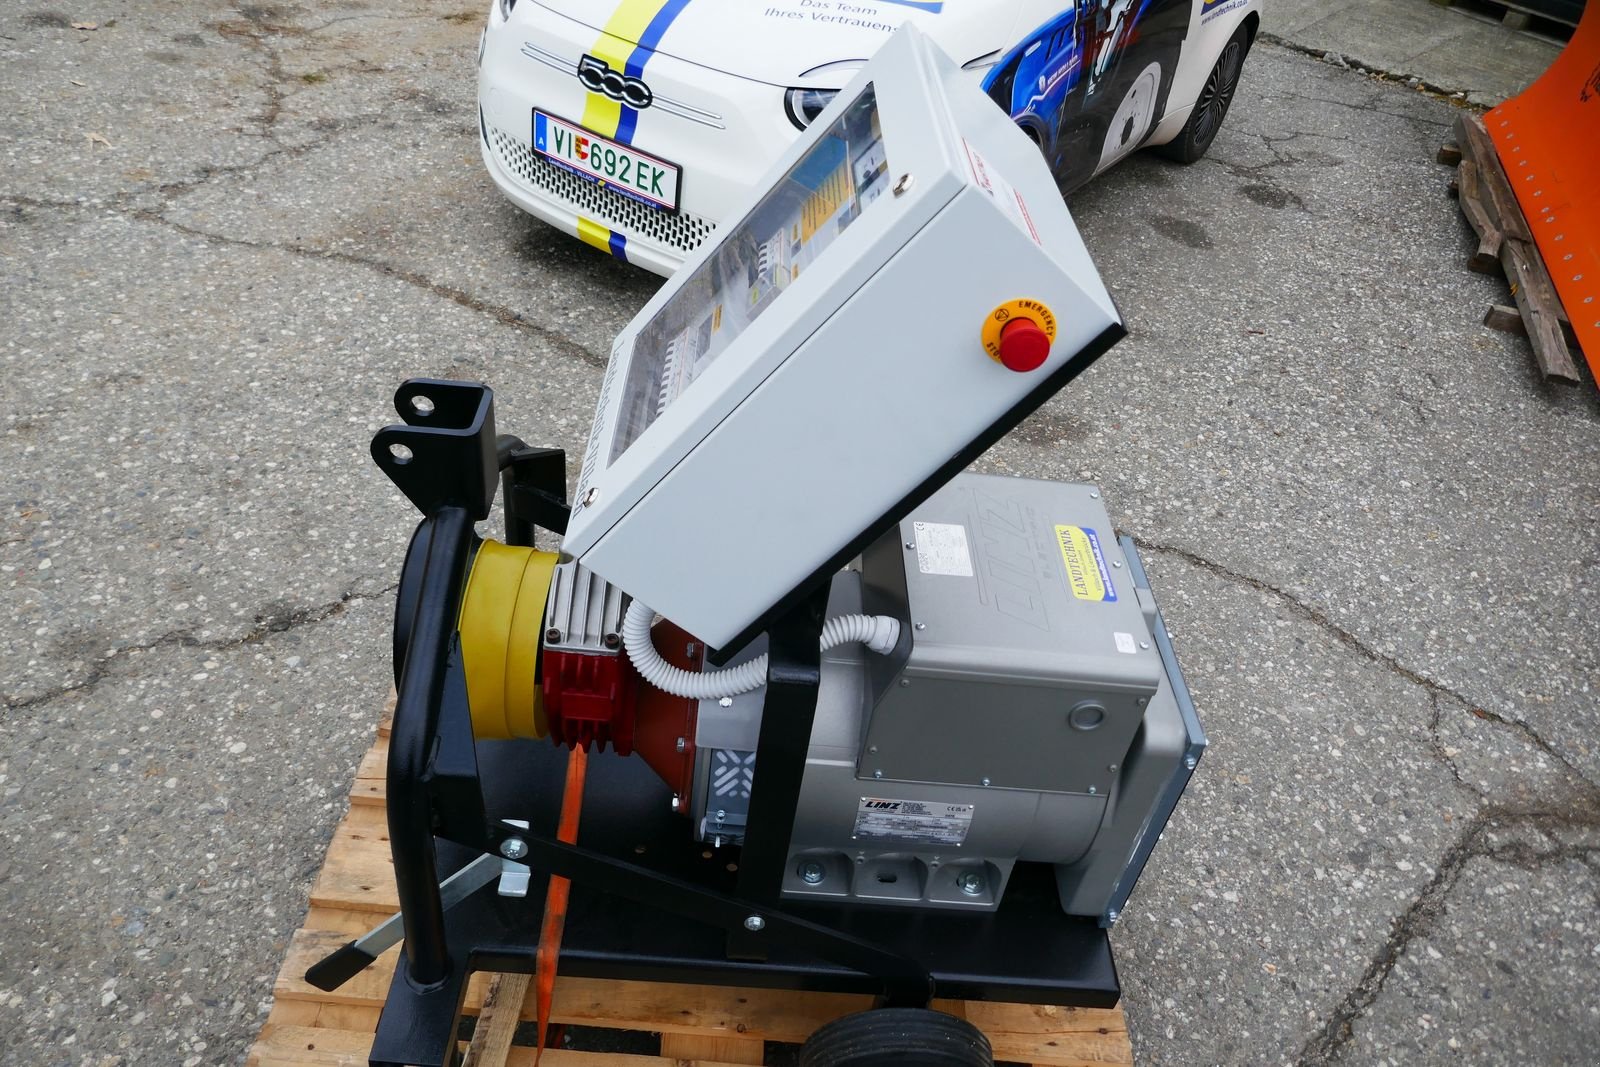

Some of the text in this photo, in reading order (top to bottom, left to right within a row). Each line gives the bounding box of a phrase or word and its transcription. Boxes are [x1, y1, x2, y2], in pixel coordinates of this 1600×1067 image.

[764, 8, 804, 20] Ihres
[800, 0, 878, 16] Das Team
[577, 53, 653, 108] 500
[538, 126, 665, 198] A VI 692 EK
[1018, 300, 1055, 337] EMERGENCY
[986, 342, 1001, 359] STO
[1057, 528, 1090, 596] LANDTECHNIK
[864, 800, 901, 809] LINZ
